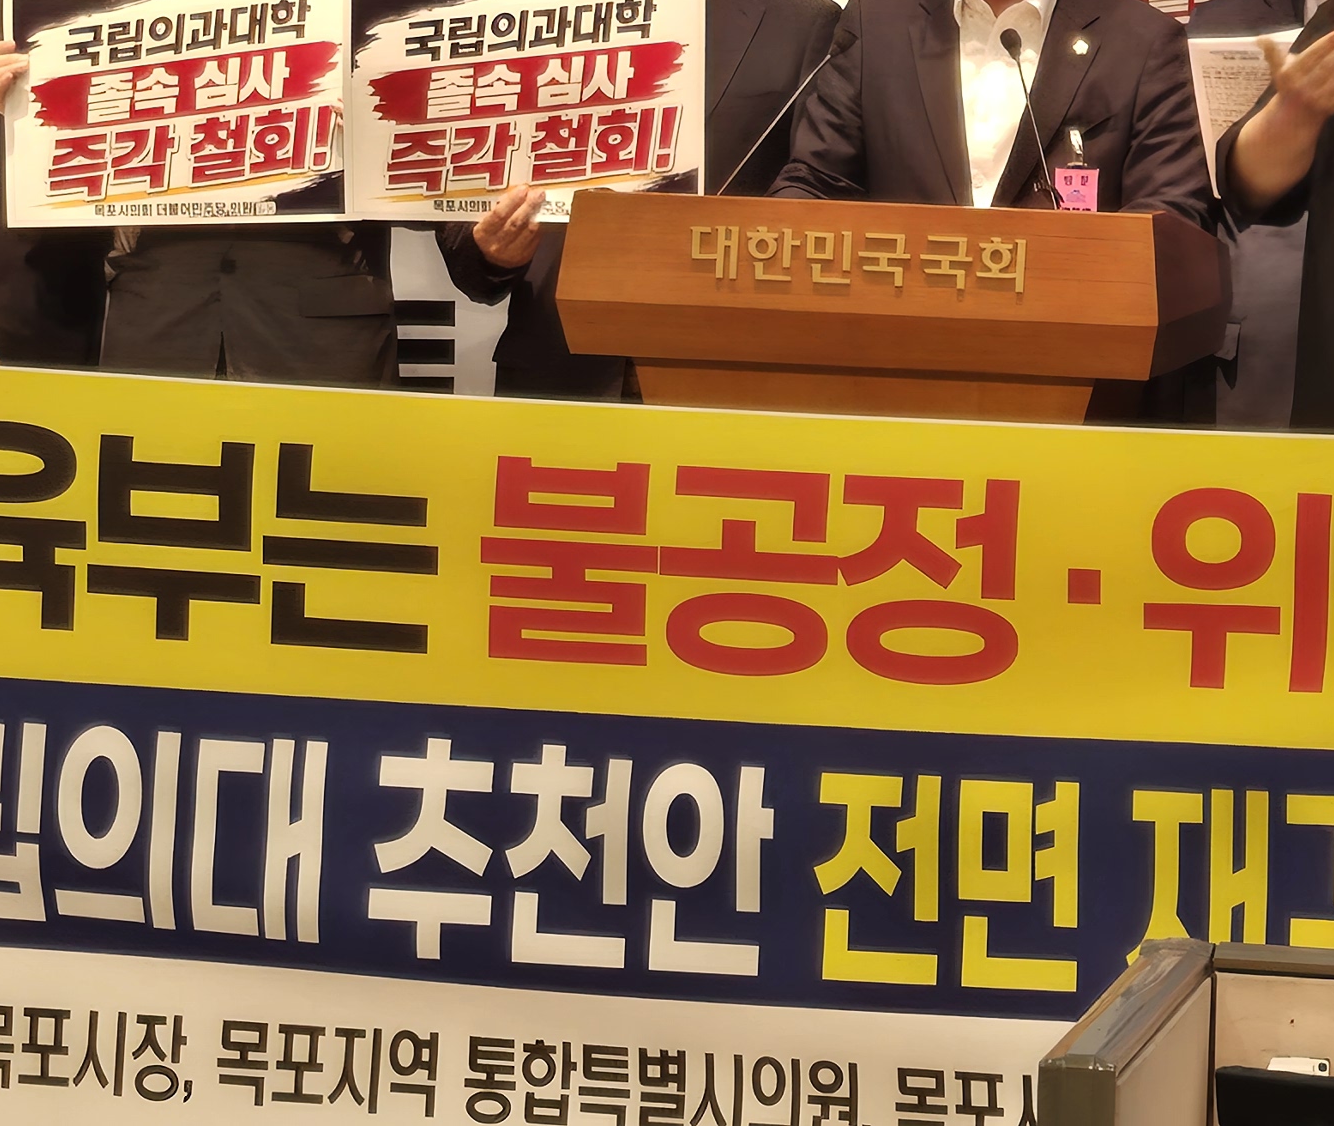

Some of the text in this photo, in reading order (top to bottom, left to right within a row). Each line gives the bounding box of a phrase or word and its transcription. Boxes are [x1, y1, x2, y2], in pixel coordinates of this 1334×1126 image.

[88, 52, 289, 120] 졸속 심사
[425, 51, 633, 120] 졸속 심사
[48, 127, 176, 198] 즉각
[191, 105, 333, 183] 철회!
[386, 105, 681, 196] 즉각 철회!
[691, 226, 1027, 293] 대한민국국회
[367, 737, 773, 978] 추천안
[814, 770, 1079, 993] 전면
[216, 1017, 440, 1118] 목포지역
[465, 1034, 871, 1126] 통합특별시의원
